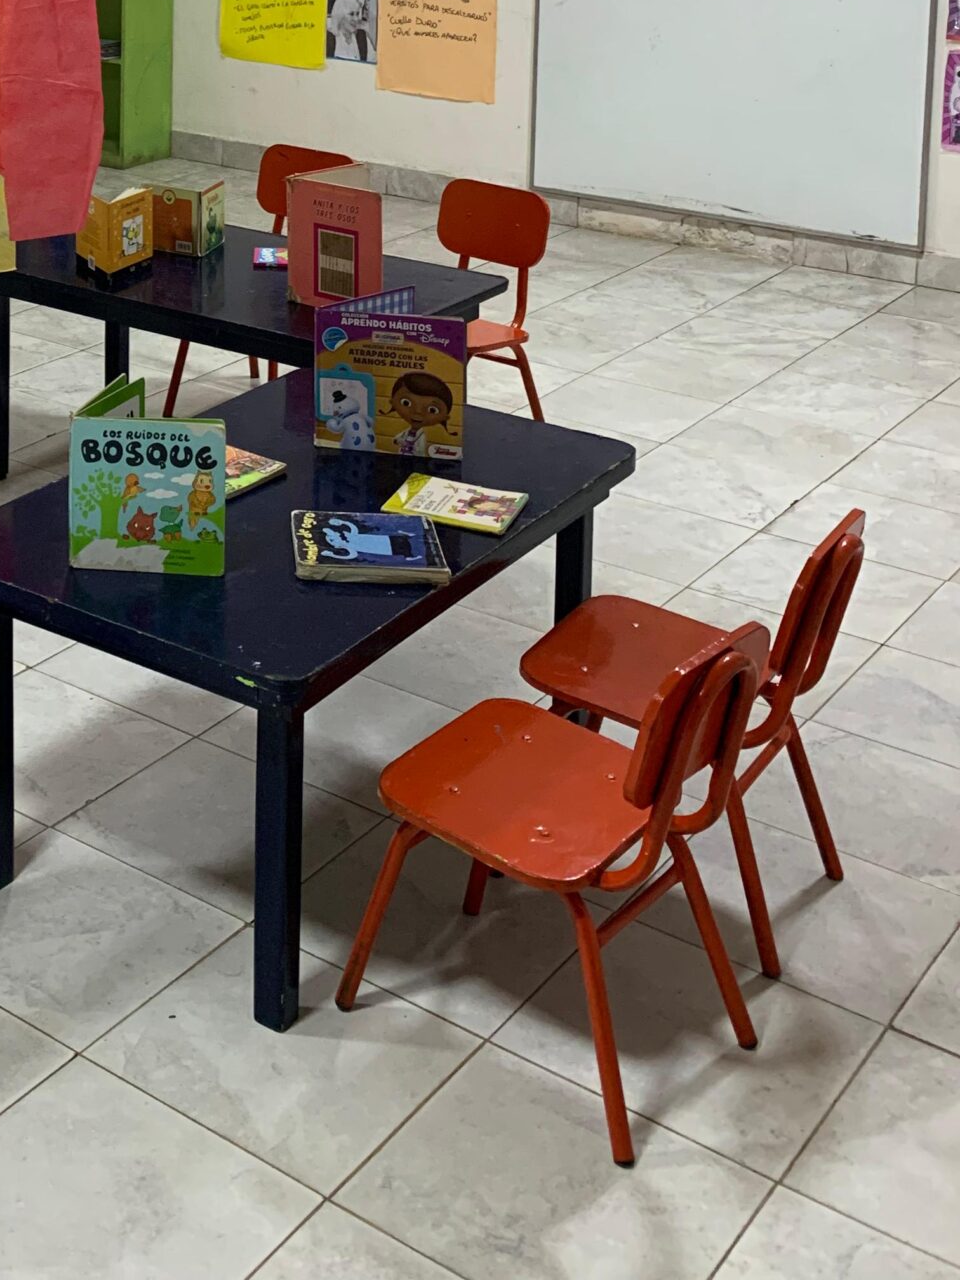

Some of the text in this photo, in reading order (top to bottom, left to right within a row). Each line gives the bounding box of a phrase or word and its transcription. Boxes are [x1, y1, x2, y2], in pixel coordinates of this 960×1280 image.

[313, 199, 334, 209] ANITA
[346, 205, 360, 215] LOS
[316, 209, 356, 224] TRES OSOS
[340, 317, 432, 332] APRENDO HÁBITOS
[419, 332, 450, 347] Disney
[348, 349, 429, 362] ATRAPADO CON LAS
[353, 357, 425, 370] MANOS AZULES
[103, 430, 122, 438] LOS
[170, 433, 190, 442] DEL
[81, 439, 217, 470] BOSQUE
[301, 512, 317, 529] ogro
